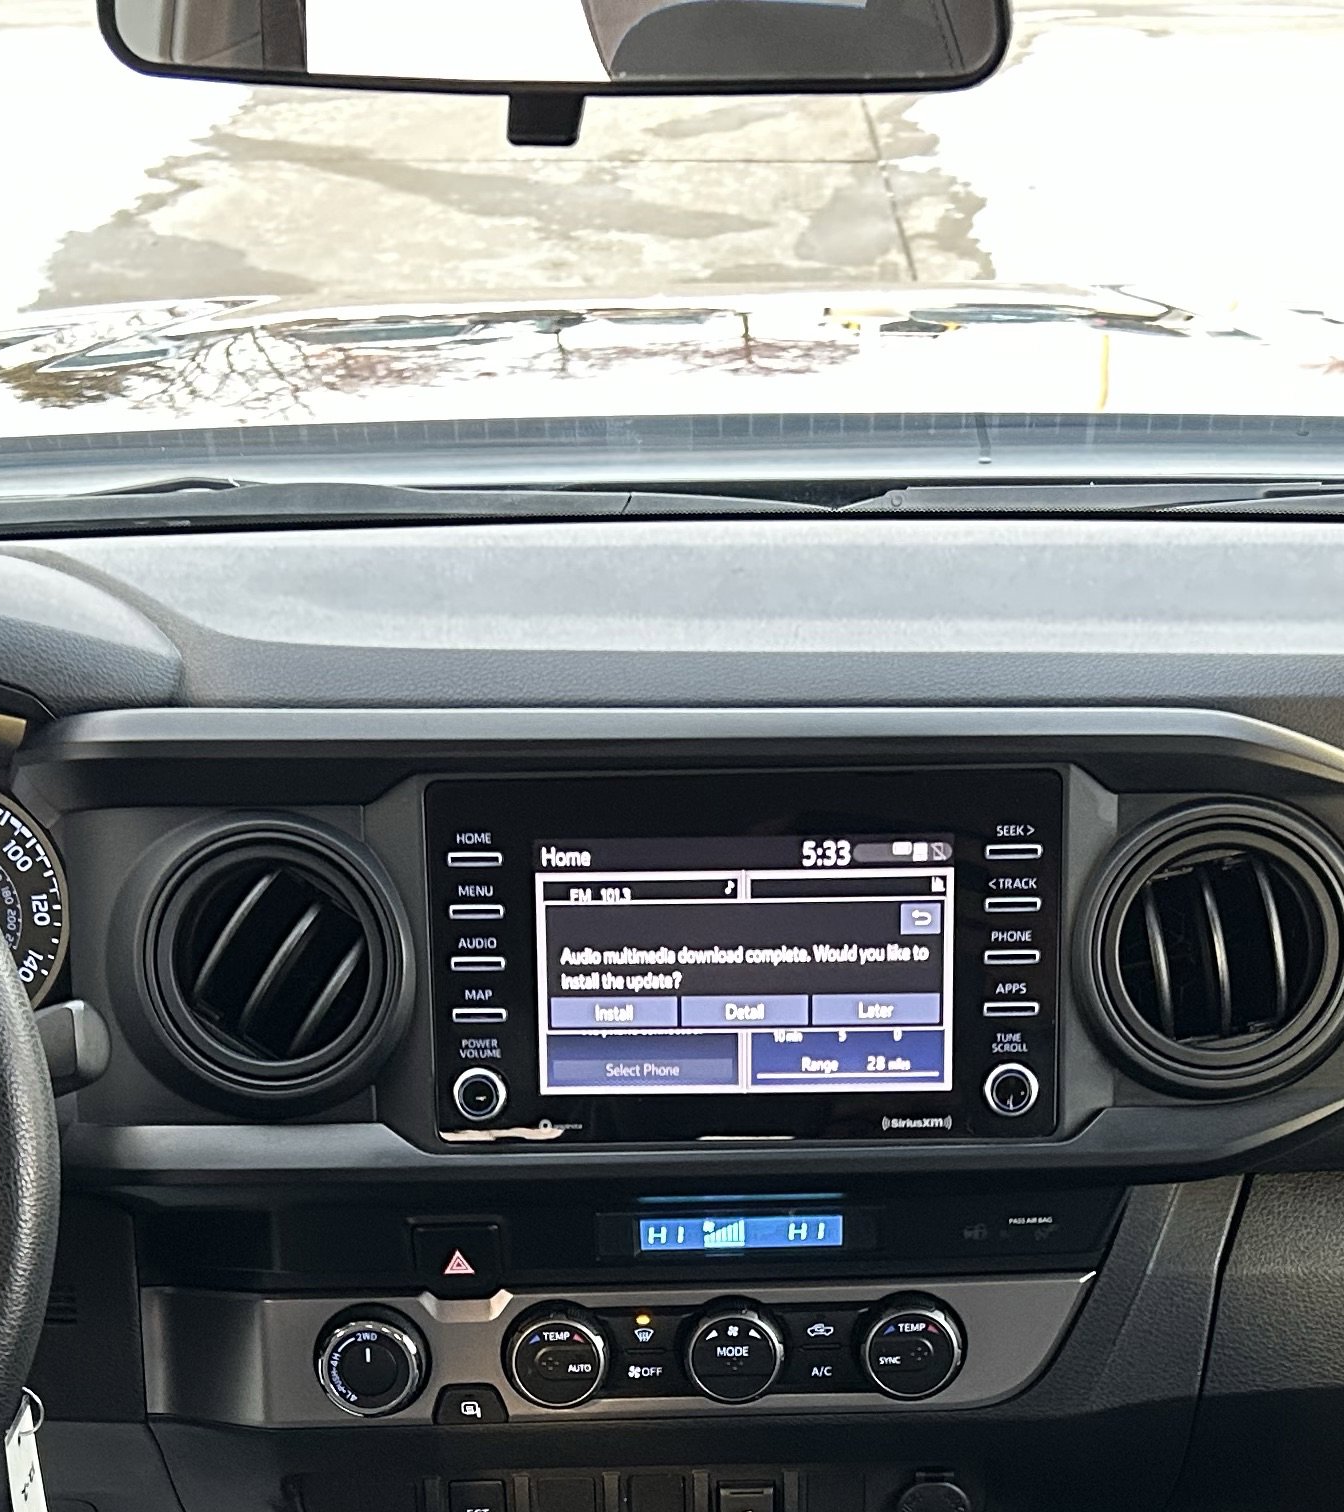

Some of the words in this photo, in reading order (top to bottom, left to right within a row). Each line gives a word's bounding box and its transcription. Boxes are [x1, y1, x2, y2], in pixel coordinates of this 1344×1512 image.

[456, 832, 492, 845] HOME
[2, 839, 33, 872] 100
[541, 846, 591, 867] Home
[802, 841, 851, 867] 5:33
[458, 885, 494, 897] MENU
[570, 888, 591, 902] FM
[30, 893, 51, 926] 120
[991, 930, 1033, 942] PHONE
[458, 937, 497, 949] AUDIO
[560, 947, 601, 965] Audio
[603, 947, 675, 965] multimedia
[678, 946, 743, 965] download
[745, 946, 811, 970] complete.
[813, 944, 857, 963] Would
[859, 948, 885, 967] you
[887, 944, 911, 962] like
[912, 946, 929, 961] to
[19, 949, 44, 983] 140
[602, 972, 624, 990] the
[626, 972, 683, 994] update?
[996, 983, 1027, 995] APPS
[464, 989, 493, 1001] MAP
[595, 1004, 633, 1022] Install
[725, 1002, 764, 1021] Detail
[858, 1002, 894, 1020] Later
[461, 1038, 498, 1049] POWER
[996, 1032, 1022, 1043] TUNE
[459, 1048, 501, 1059] VOLUME
[992, 1042, 1028, 1053] SCROLL
[605, 1064, 640, 1078] Select
[643, 1063, 680, 1077] Phone
[802, 1056, 838, 1074] Range
[867, 1056, 885, 1072] 28
[898, 1322, 926, 1332] TEMP
[356, 1332, 377, 1342] 2WD
[542, 1331, 571, 1341] TEMP
[716, 1346, 749, 1357] MODE
[879, 1356, 901, 1365] SYNC
[568, 1364, 592, 1373] AUTO
[642, 1366, 663, 1377] OFF
[811, 1366, 832, 1377] A/C
